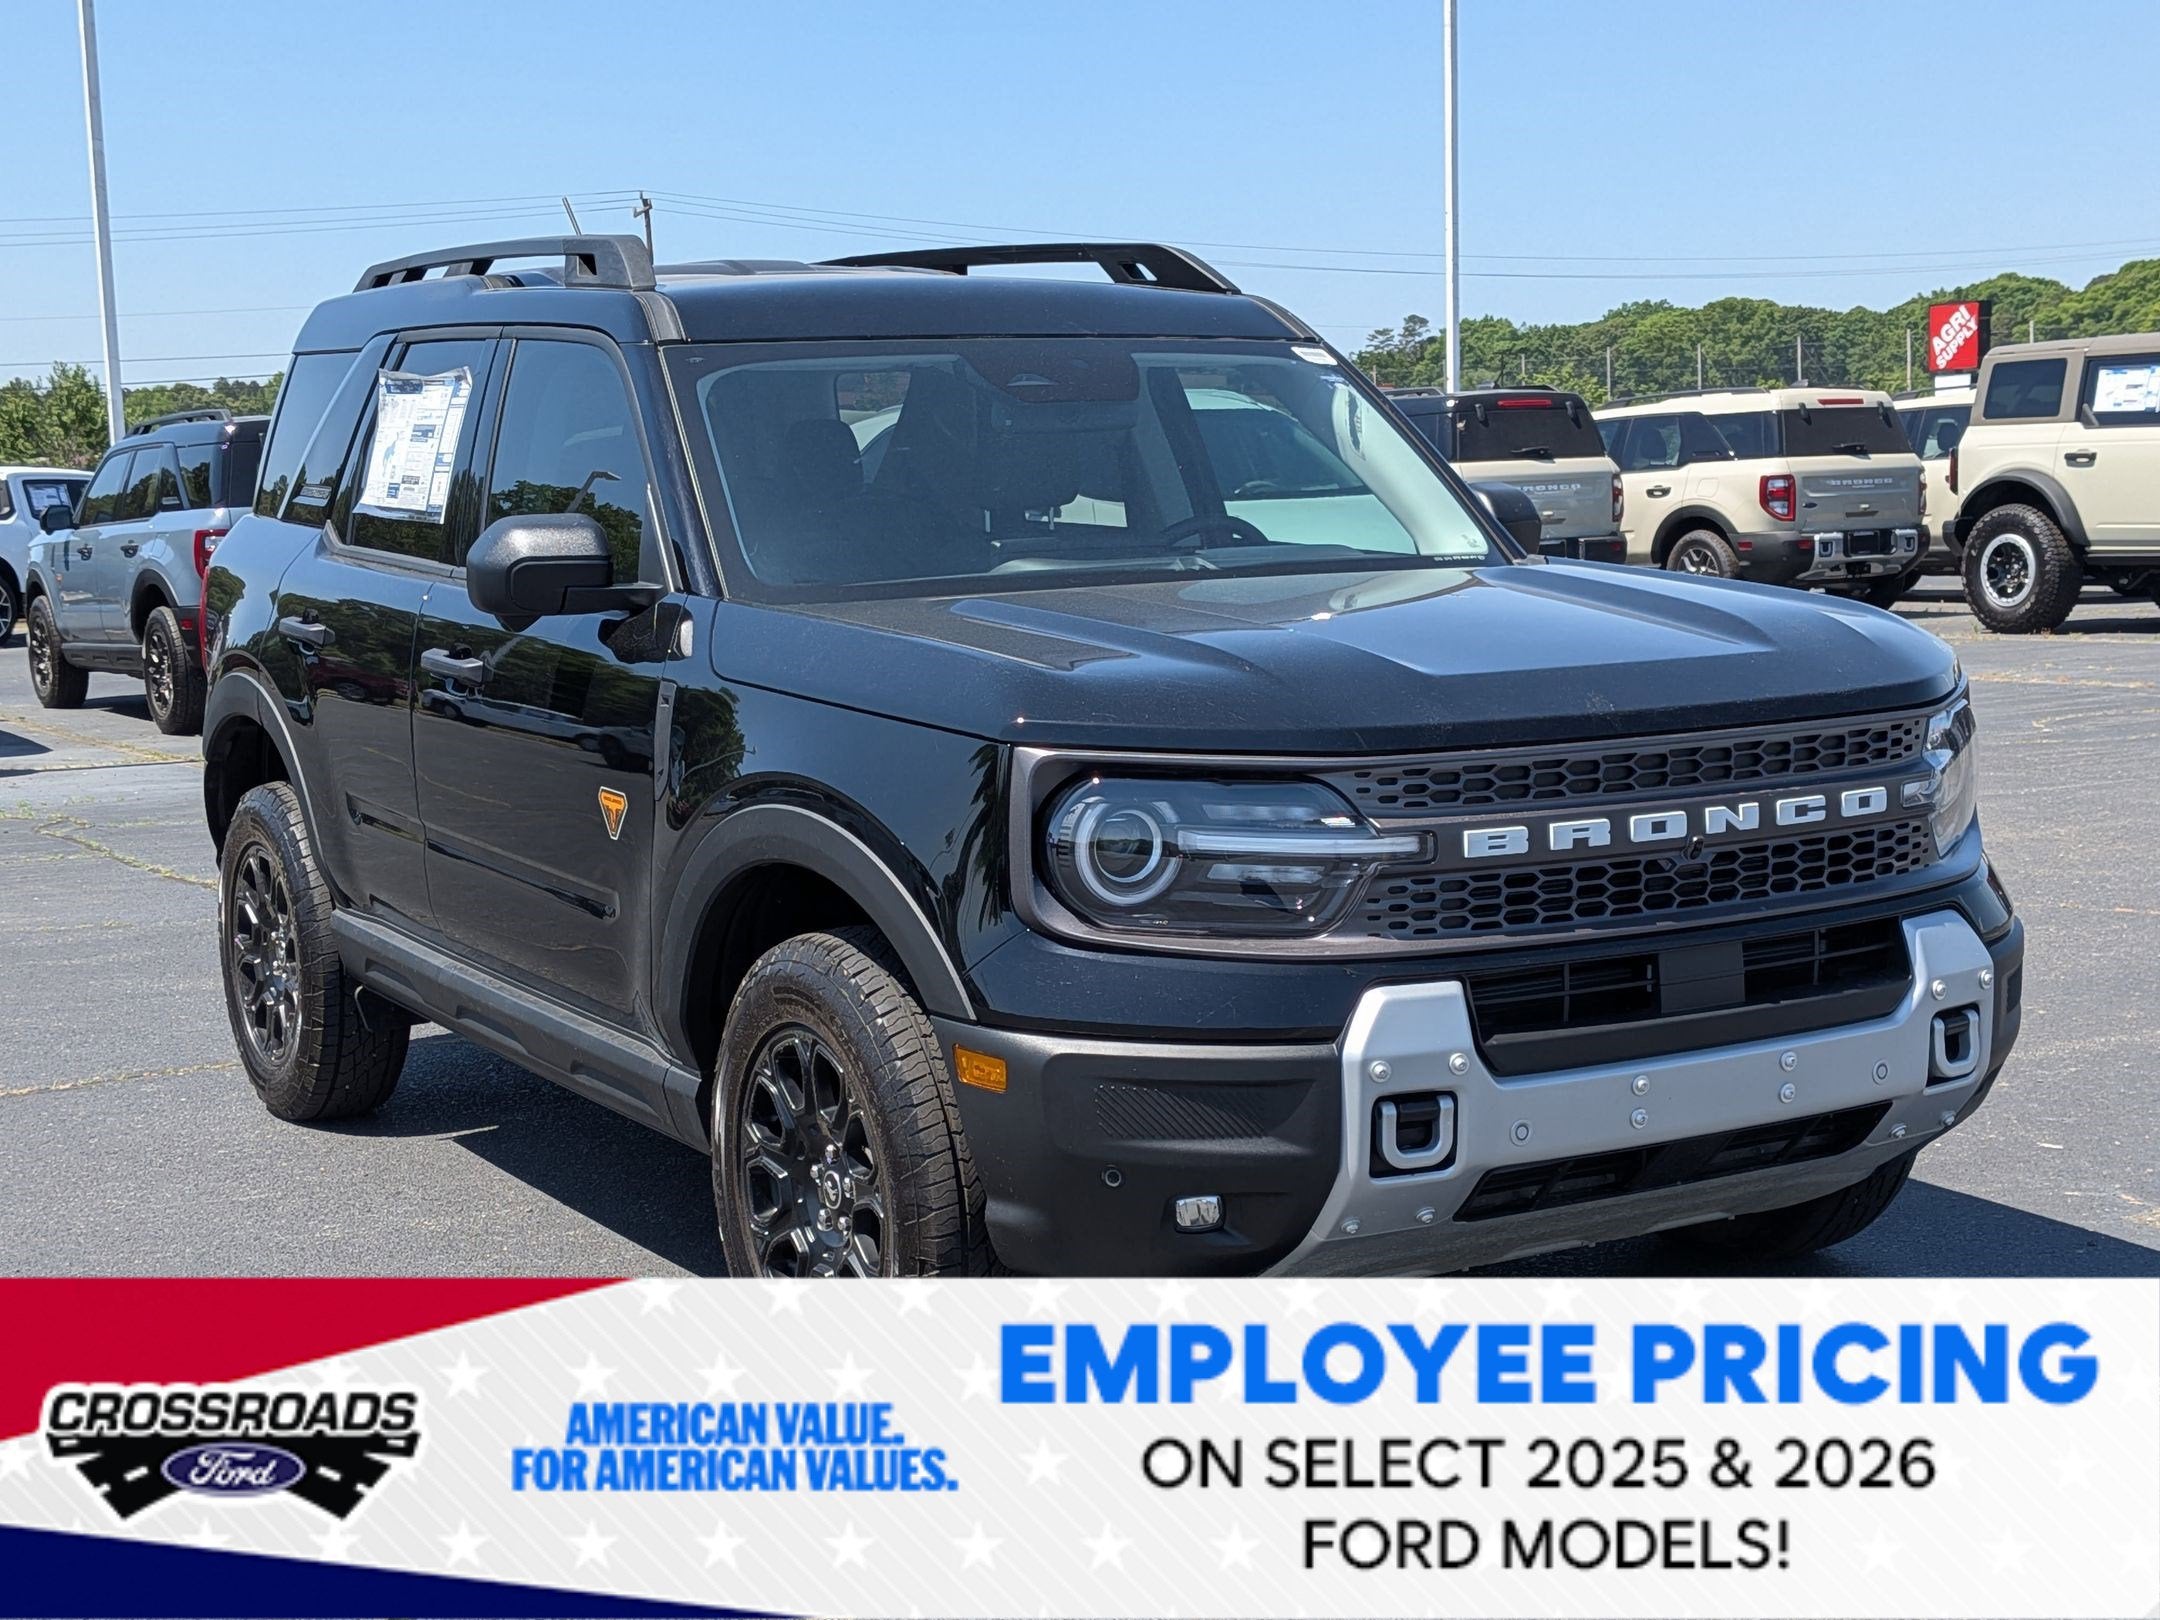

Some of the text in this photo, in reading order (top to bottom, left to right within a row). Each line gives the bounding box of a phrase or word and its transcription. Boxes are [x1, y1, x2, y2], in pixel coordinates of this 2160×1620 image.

[1932, 304, 1971, 356] AGRI
[1936, 314, 1979, 369] SUPPLY
[1462, 786, 1888, 859] BRONCO
